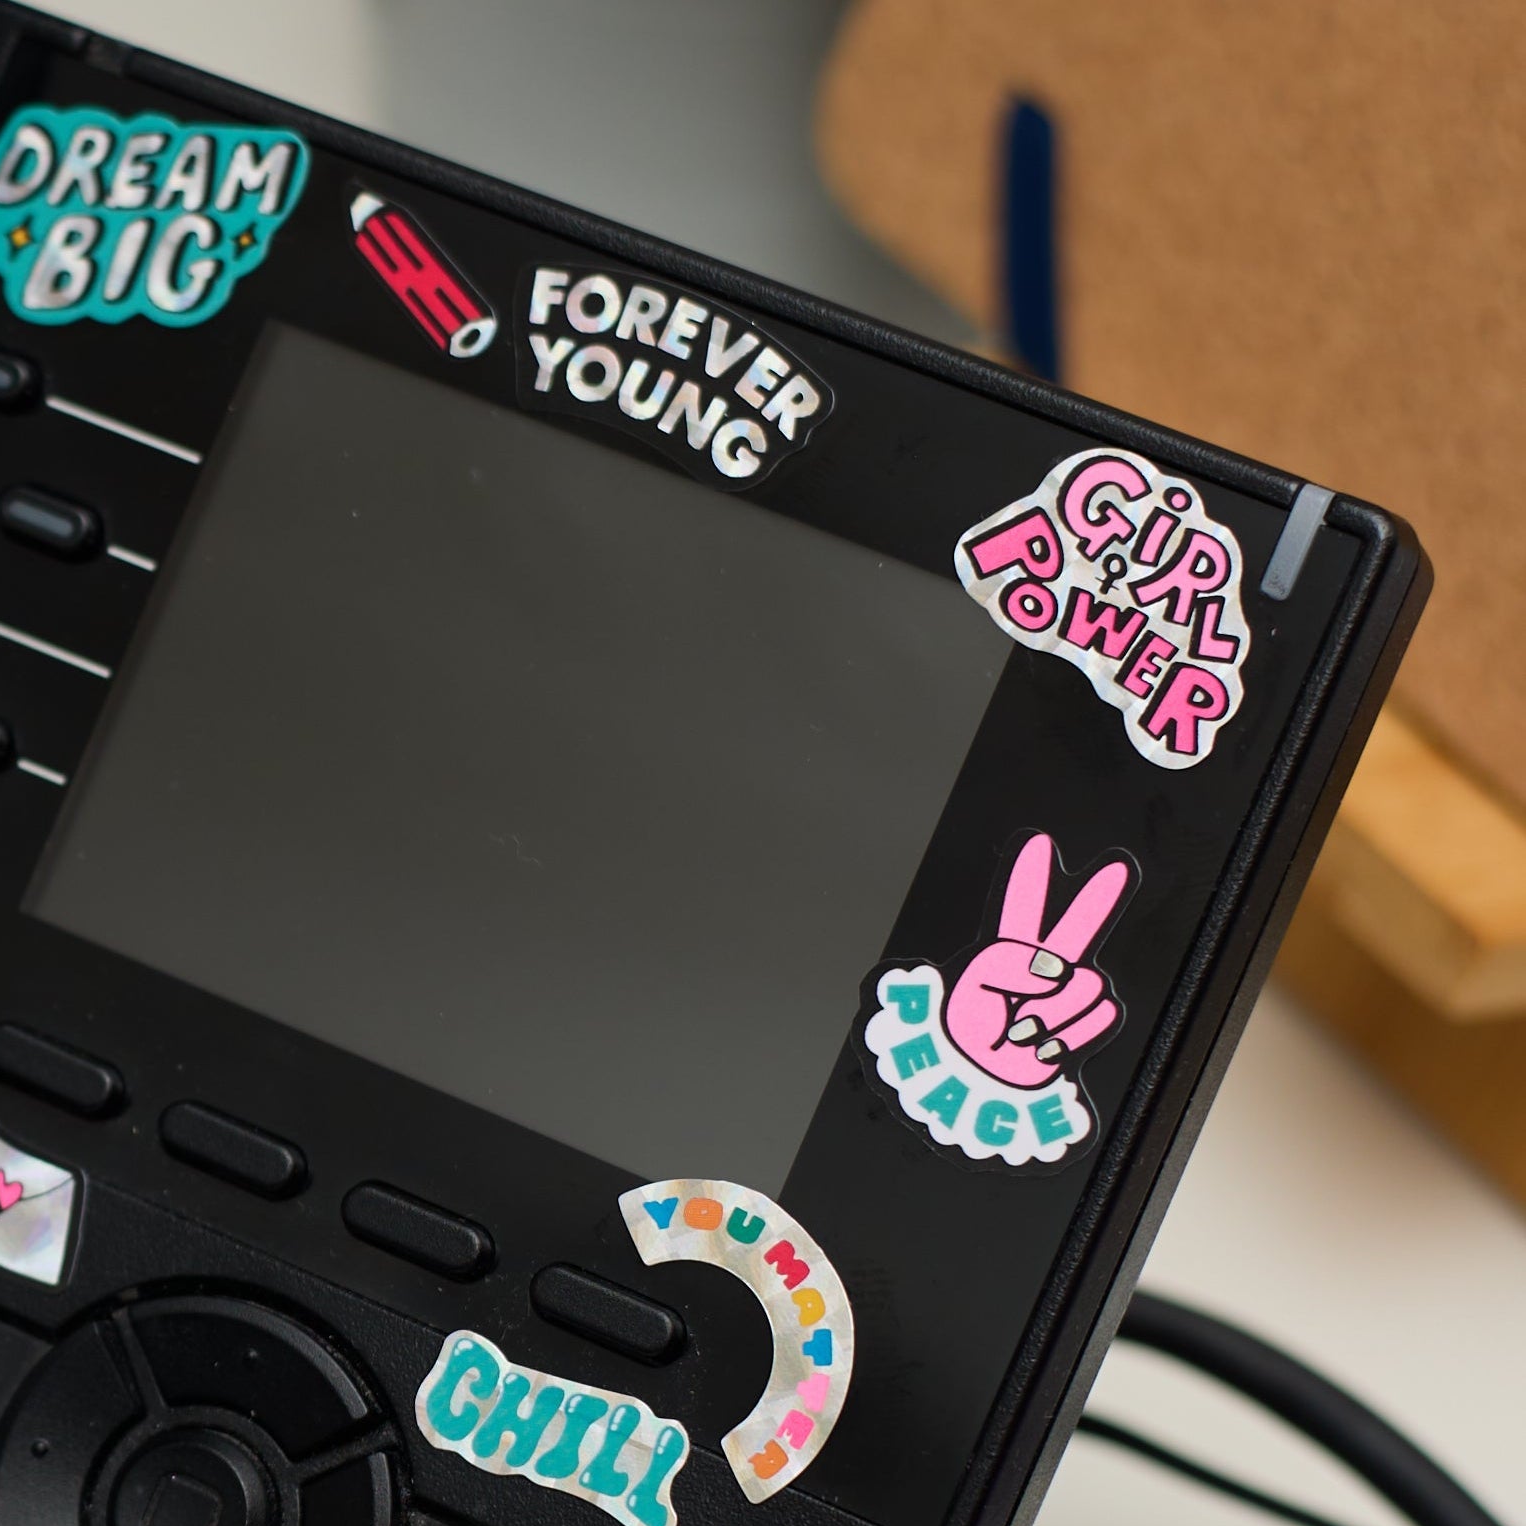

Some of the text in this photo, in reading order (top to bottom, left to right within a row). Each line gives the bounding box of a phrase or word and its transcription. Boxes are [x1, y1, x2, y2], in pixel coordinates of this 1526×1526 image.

[22, 214, 224, 313] BIG
[528, 266, 821, 441] FOREVER
[528, 332, 768, 479] YOUNG
[962, 506, 1230, 756] POWER
[886, 983, 1075, 1147] PEACE
[643, 1196, 833, 1480] YOU MATTER
